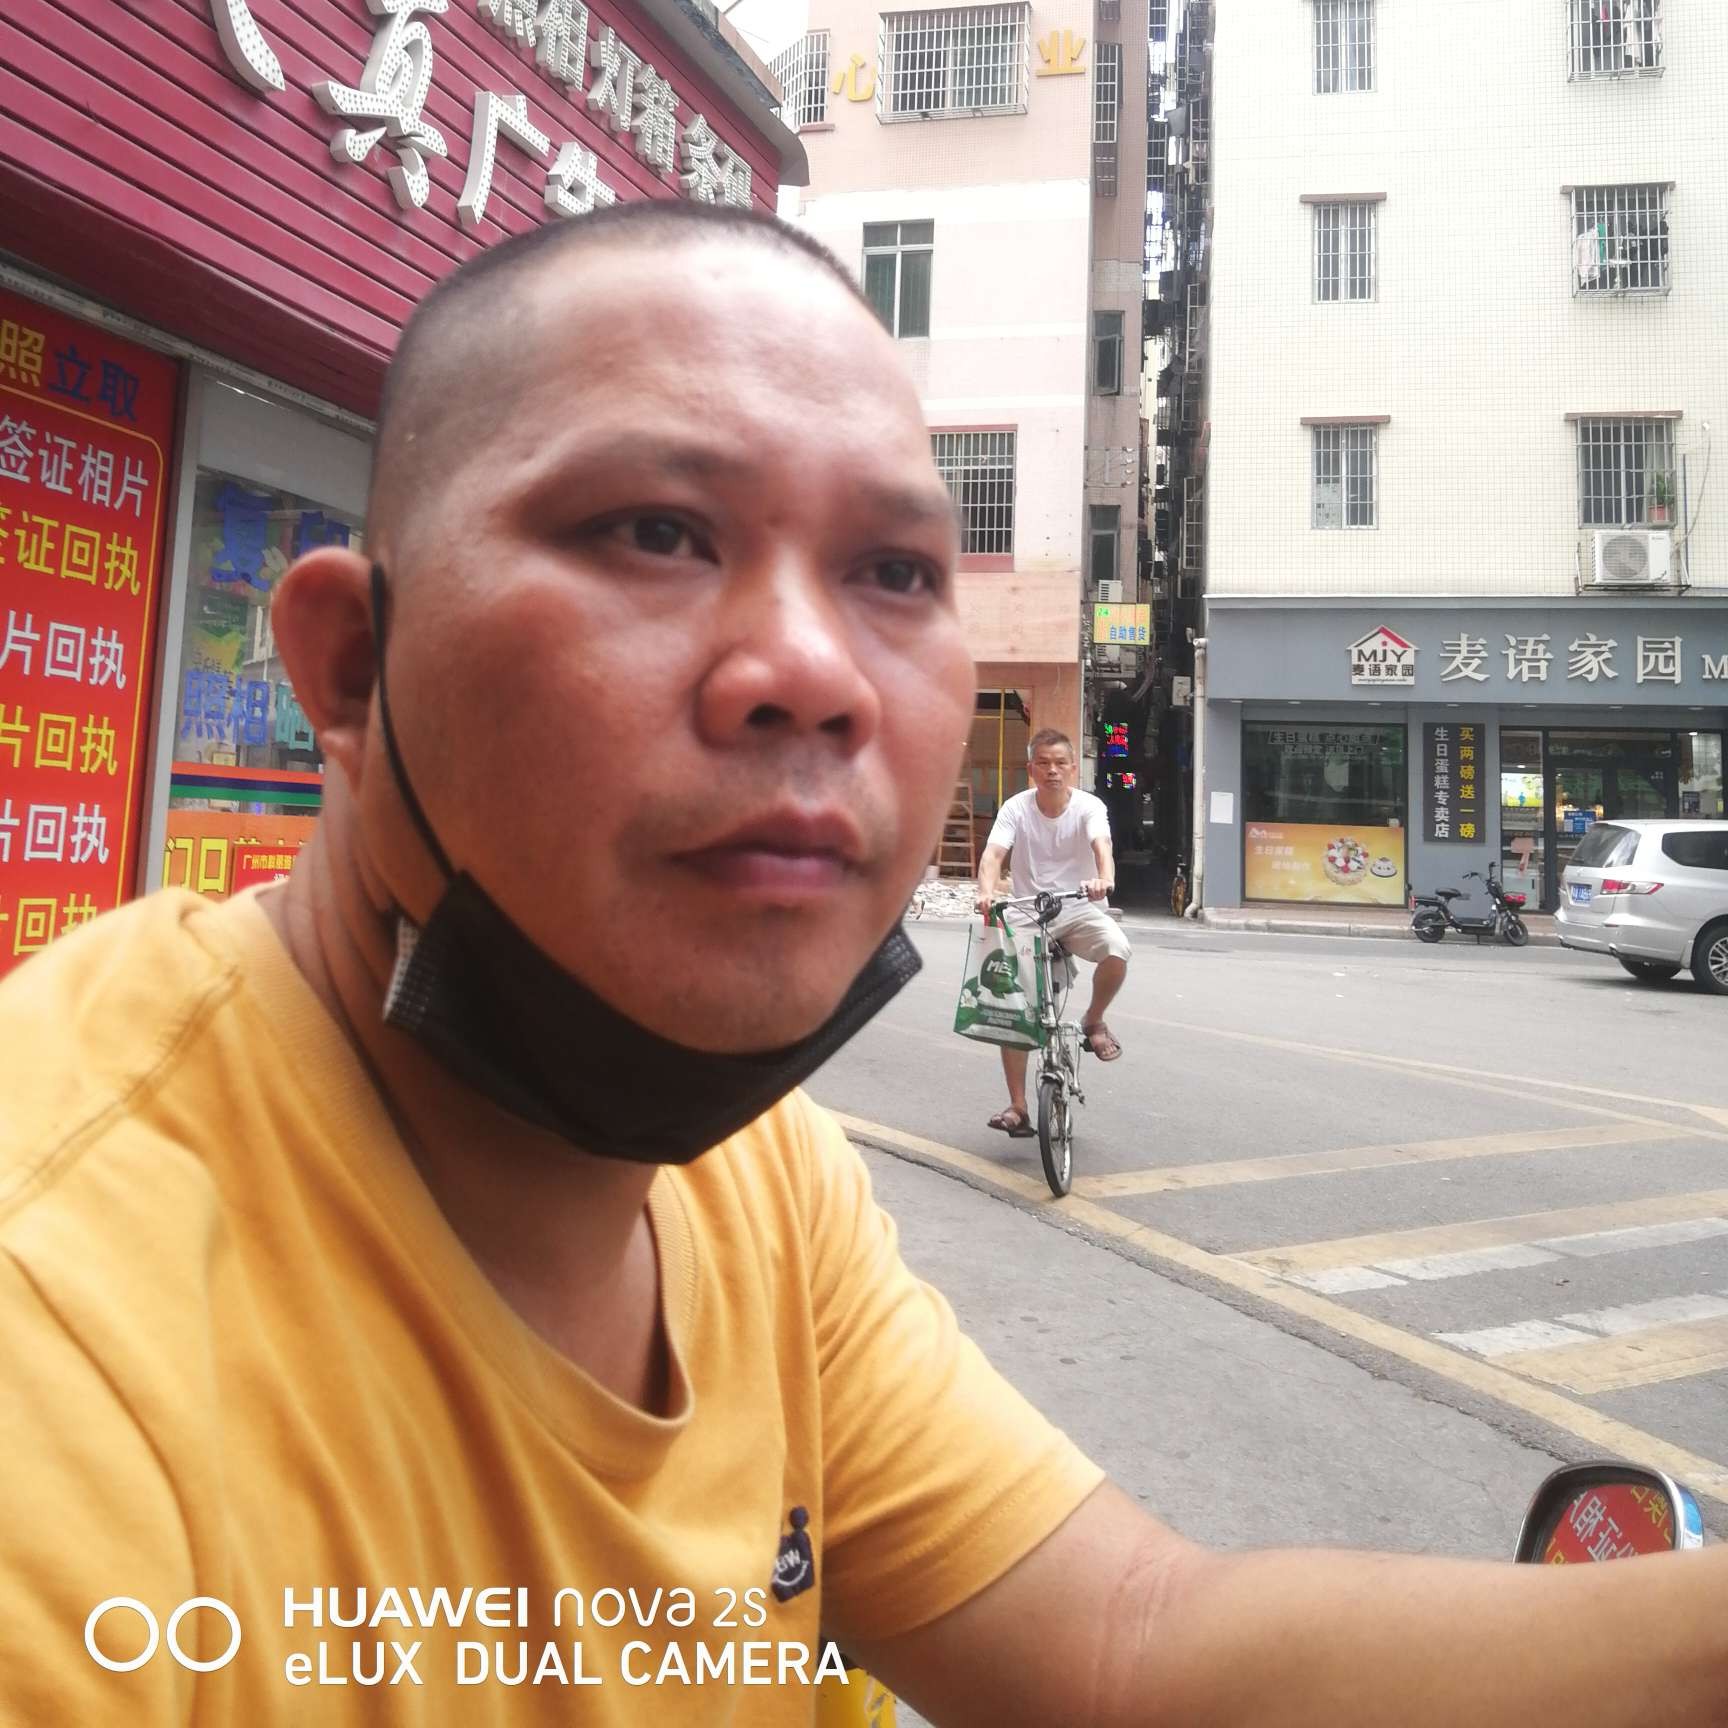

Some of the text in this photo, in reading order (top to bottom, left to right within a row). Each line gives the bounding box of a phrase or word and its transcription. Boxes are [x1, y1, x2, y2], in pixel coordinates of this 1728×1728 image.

[832, 29, 1087, 102] 心 业
[0, 415, 149, 518] 签证相片
[1352, 664, 1414, 677] 麦语家园
[1439, 632, 1682, 684] 麦语家园
[1433, 726, 1451, 839] 生日蛋糕专卖店
[1458, 726, 1476, 839] 买两磅送一磅
